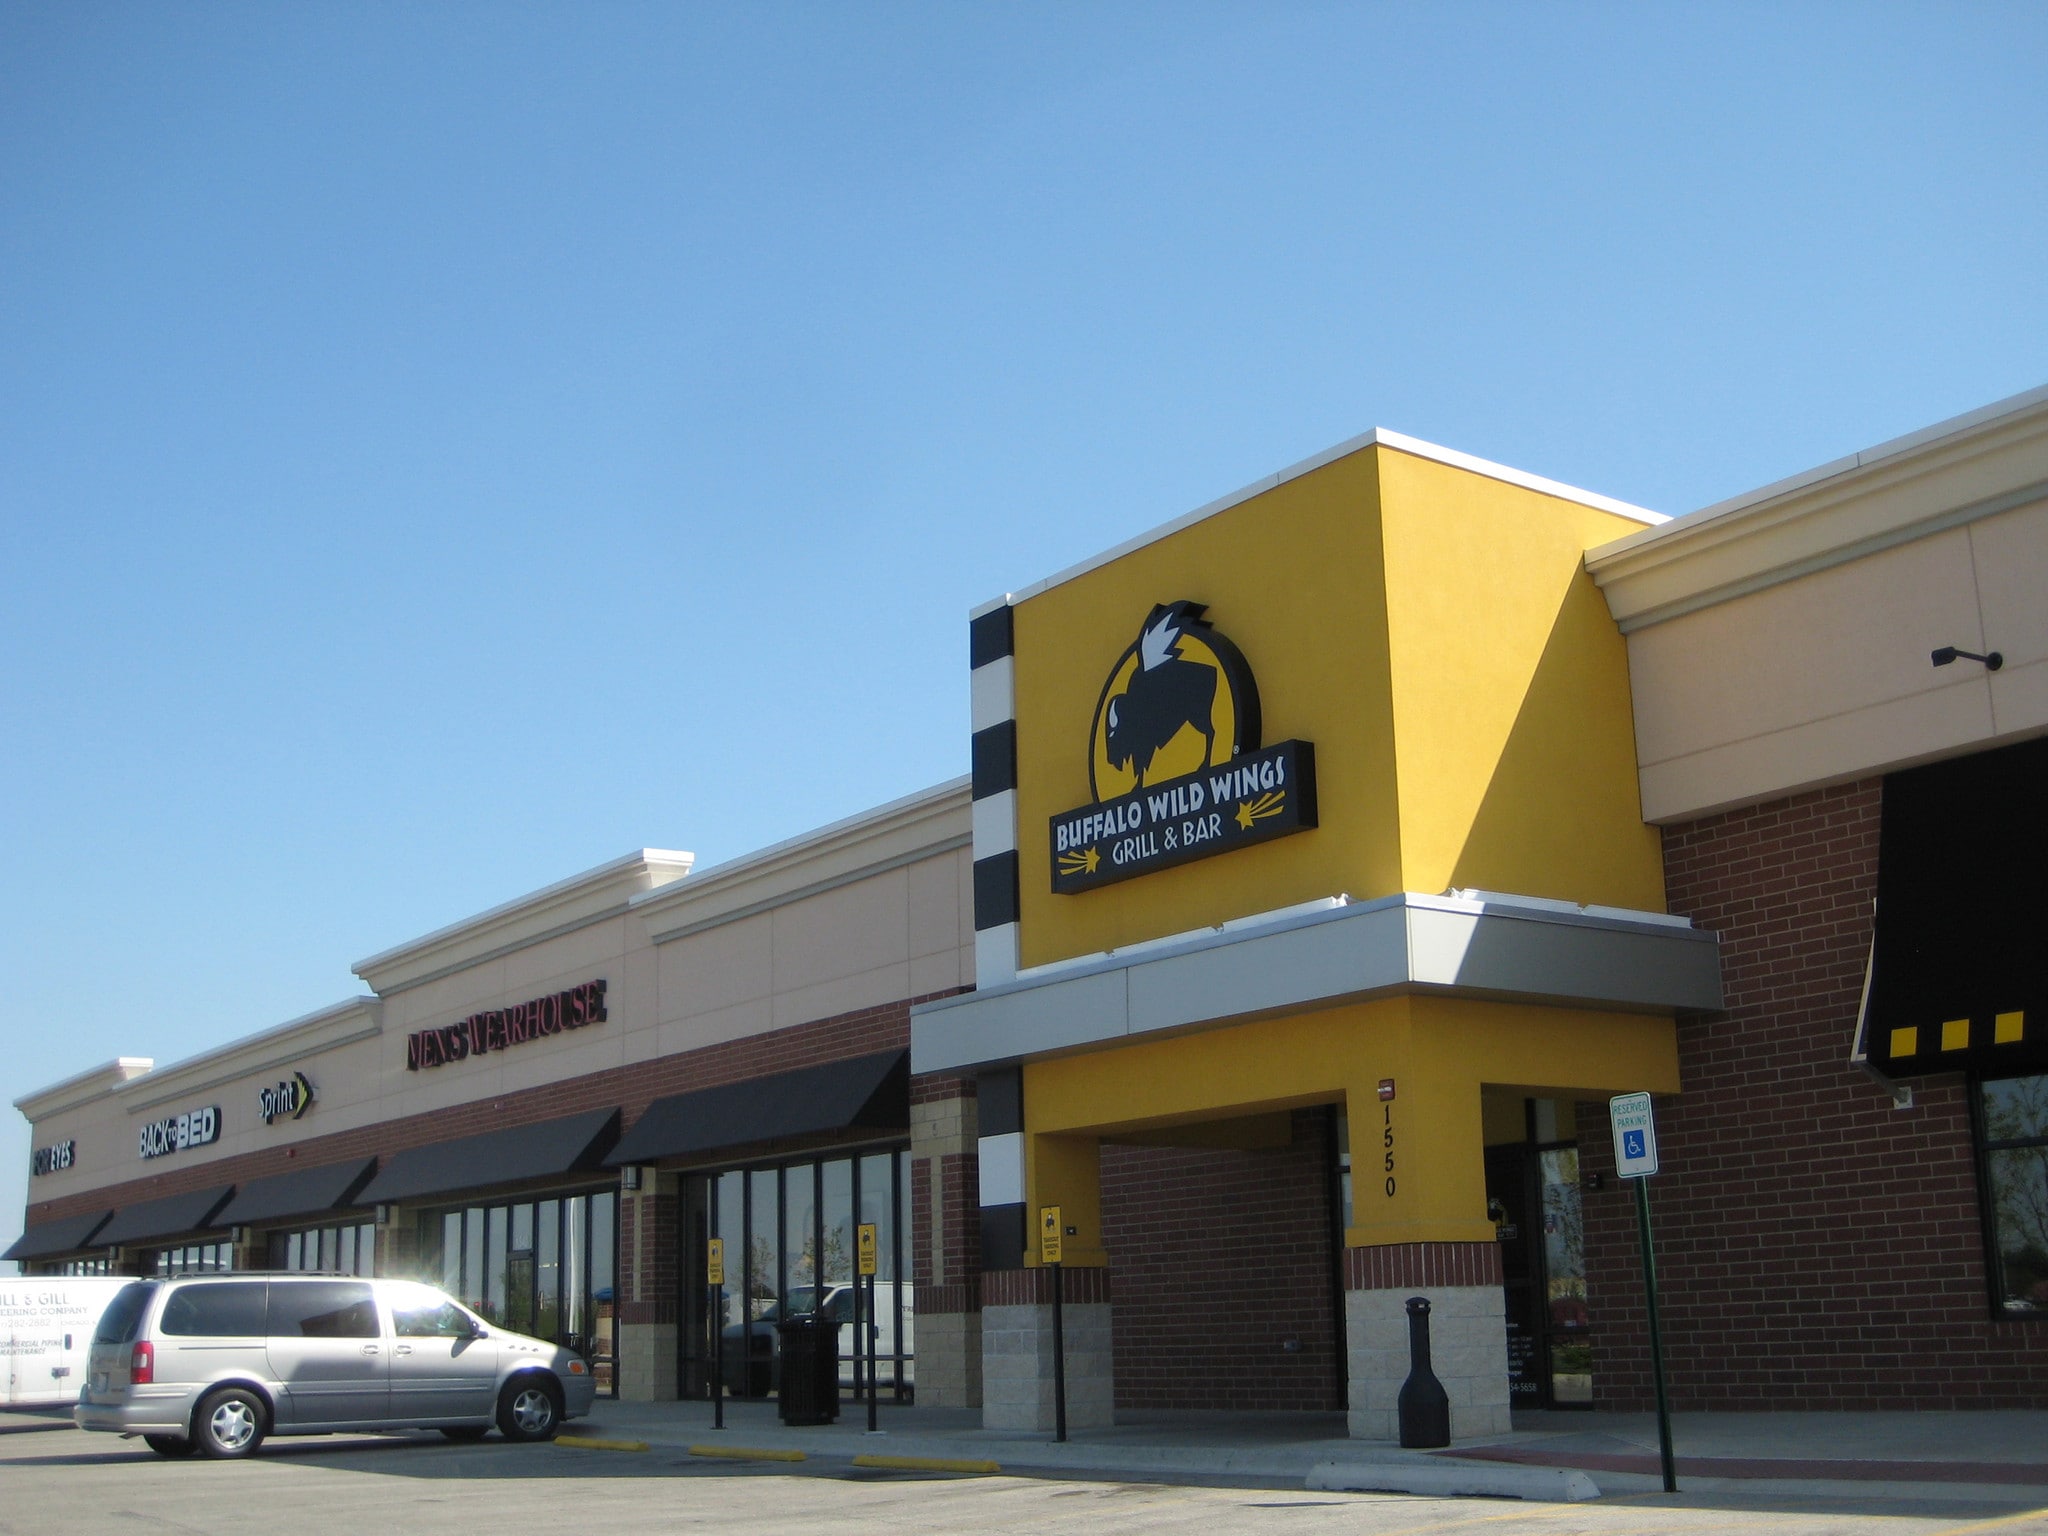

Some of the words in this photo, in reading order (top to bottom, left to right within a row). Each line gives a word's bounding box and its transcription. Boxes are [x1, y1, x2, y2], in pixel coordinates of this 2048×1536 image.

[1057, 802, 1142, 851] BUFFALO
[1147, 782, 1205, 823] WILD
[1209, 756, 1285, 804] WINGS
[1112, 831, 1159, 865] GRILL
[1163, 826, 1178, 850] &
[1183, 813, 1222, 846] BAR
[258, 1082, 295, 1124] Sprint
[1613, 1101, 1648, 1115] RESERVED
[139, 1119, 170, 1158] BACK
[168, 1127, 177, 1142] TO
[176, 1106, 216, 1149] BED
[1617, 1115, 1647, 1128] PARKING
[50, 1140, 75, 1171] EYES
[1384, 1105, 1396, 1197] 1550
[38, 1292, 70, 1305] GILL
[40, 1306, 89, 1316] COMPANY
